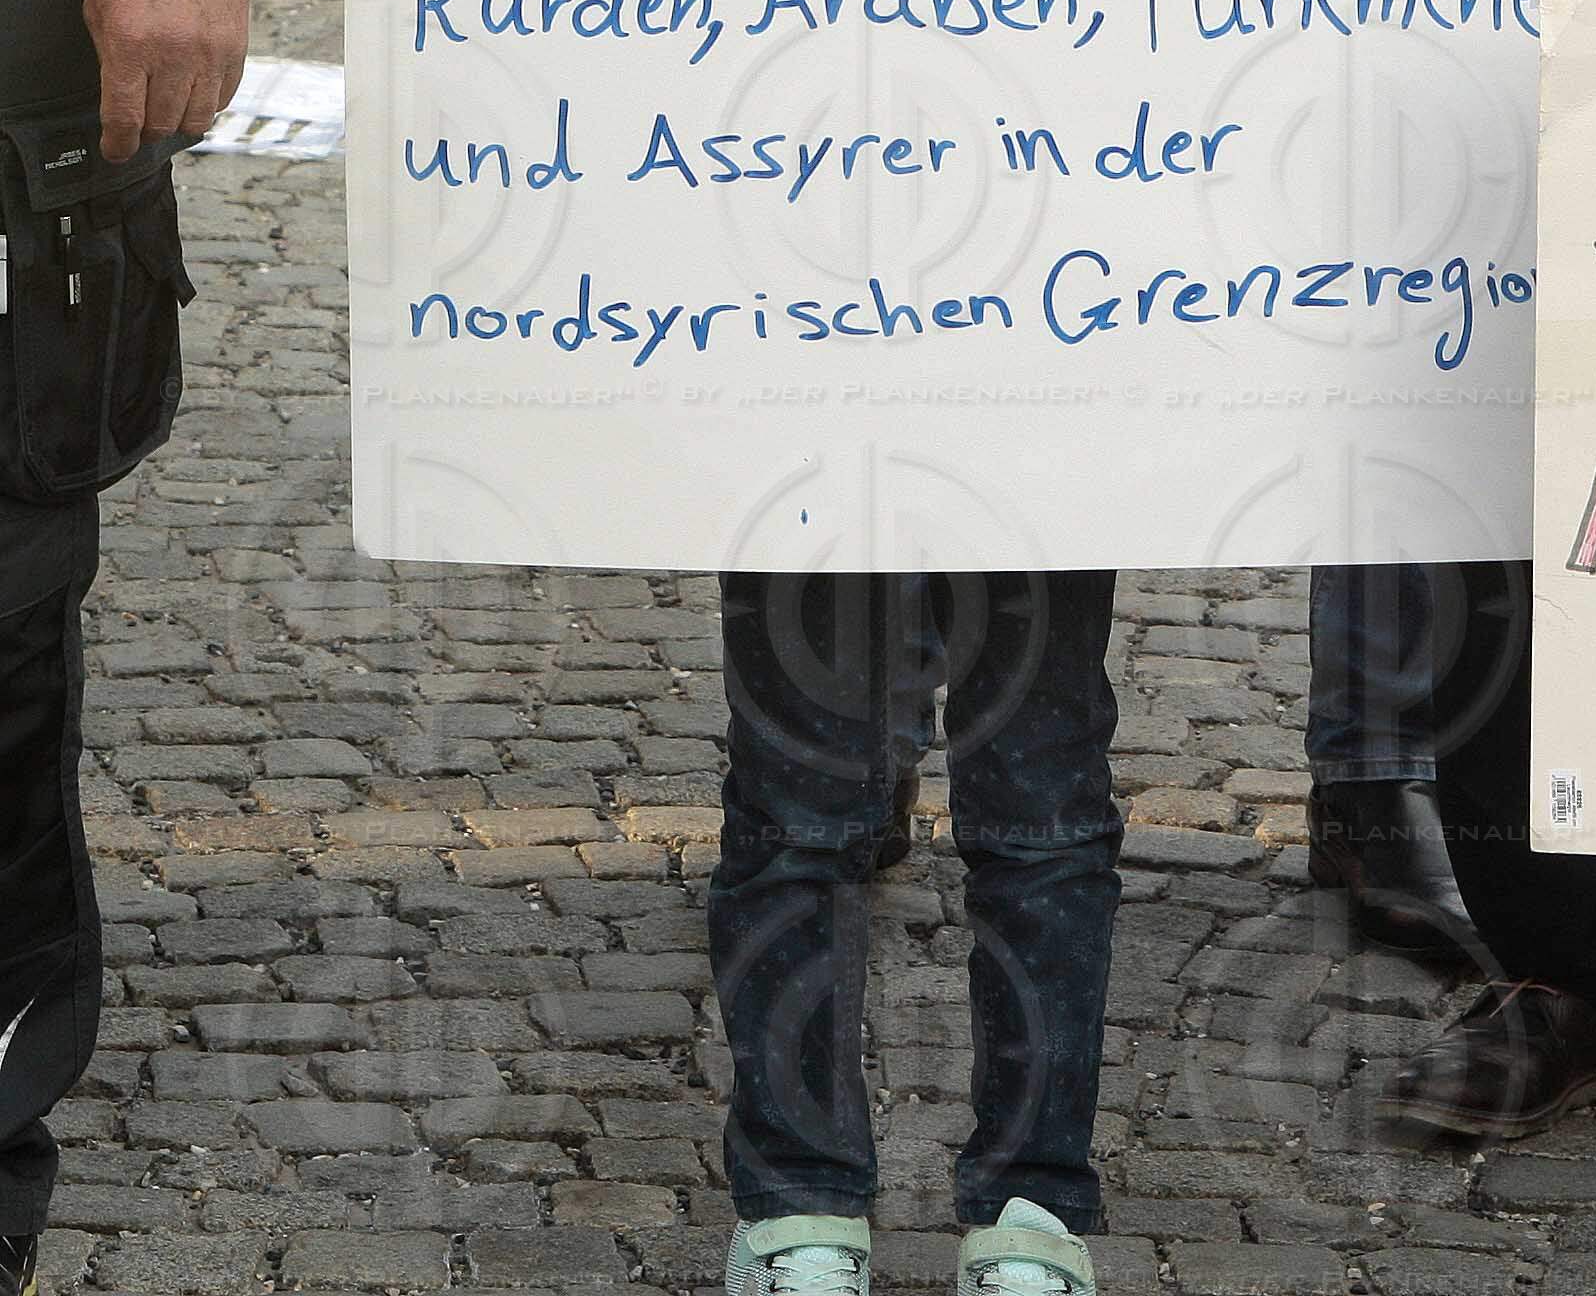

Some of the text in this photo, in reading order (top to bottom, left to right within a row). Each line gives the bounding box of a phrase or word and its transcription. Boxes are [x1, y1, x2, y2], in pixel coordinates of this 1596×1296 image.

[405, 99, 584, 191] und
[627, 113, 957, 204] Assyrer
[996, 117, 1071, 177] in
[1095, 101, 1243, 183] der
[410, 249, 1537, 371] nordsyrischen Grenzregio
